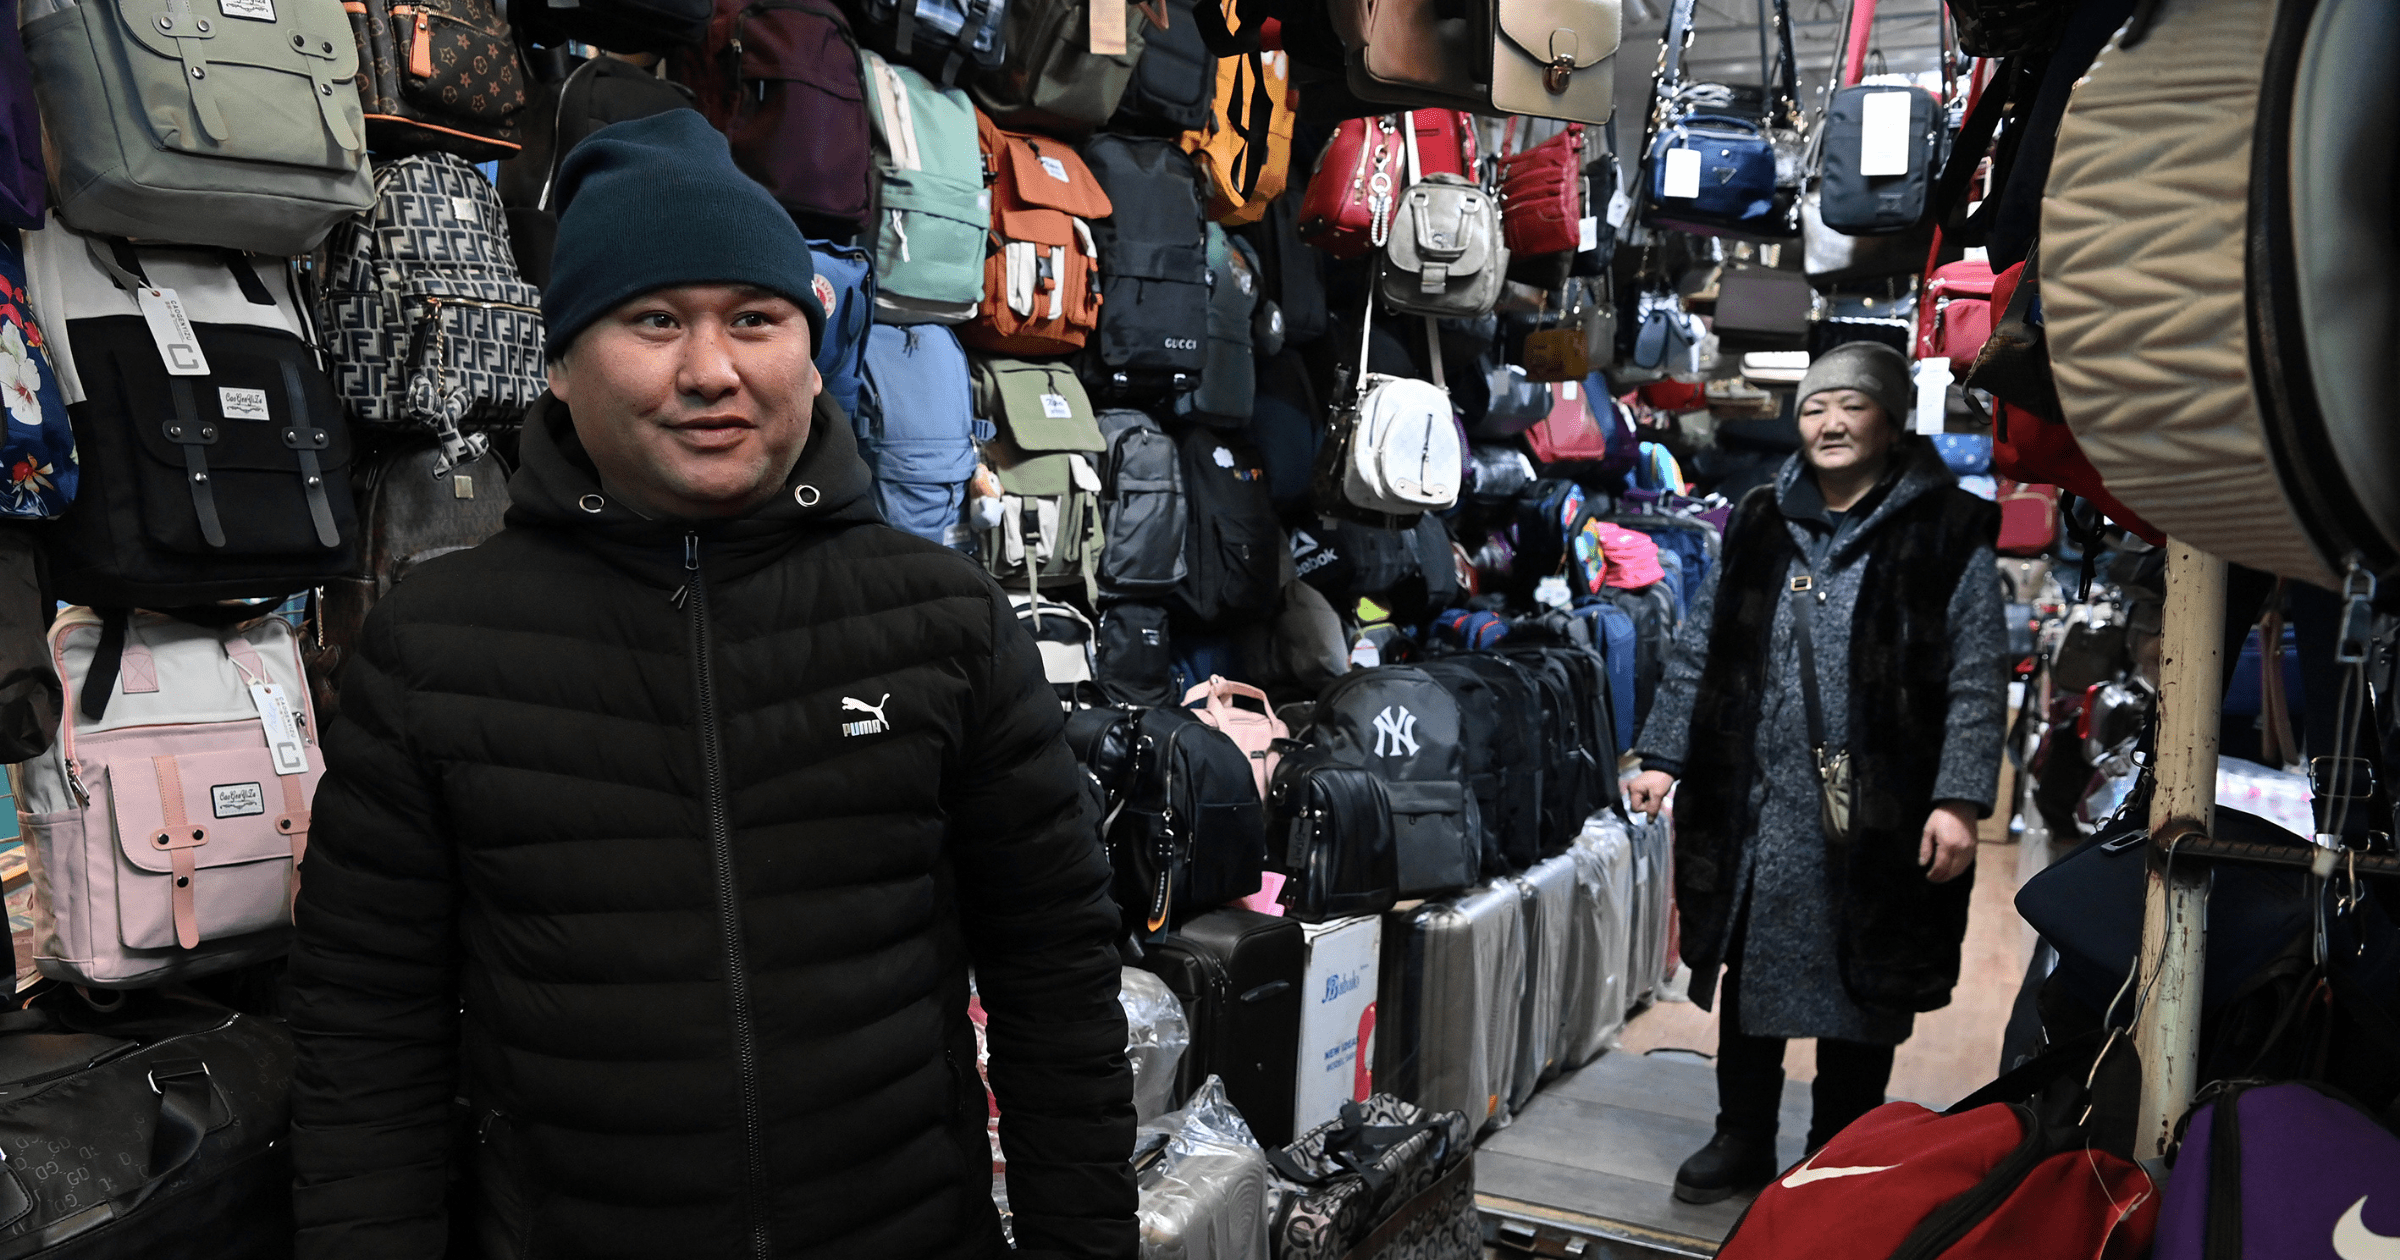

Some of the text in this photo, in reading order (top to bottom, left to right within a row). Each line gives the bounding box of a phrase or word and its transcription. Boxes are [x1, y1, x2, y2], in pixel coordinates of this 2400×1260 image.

[1164, 337, 1197, 350] GUCCI
[842, 719, 882, 737] PUMA
[1372, 705, 1421, 759] NY
